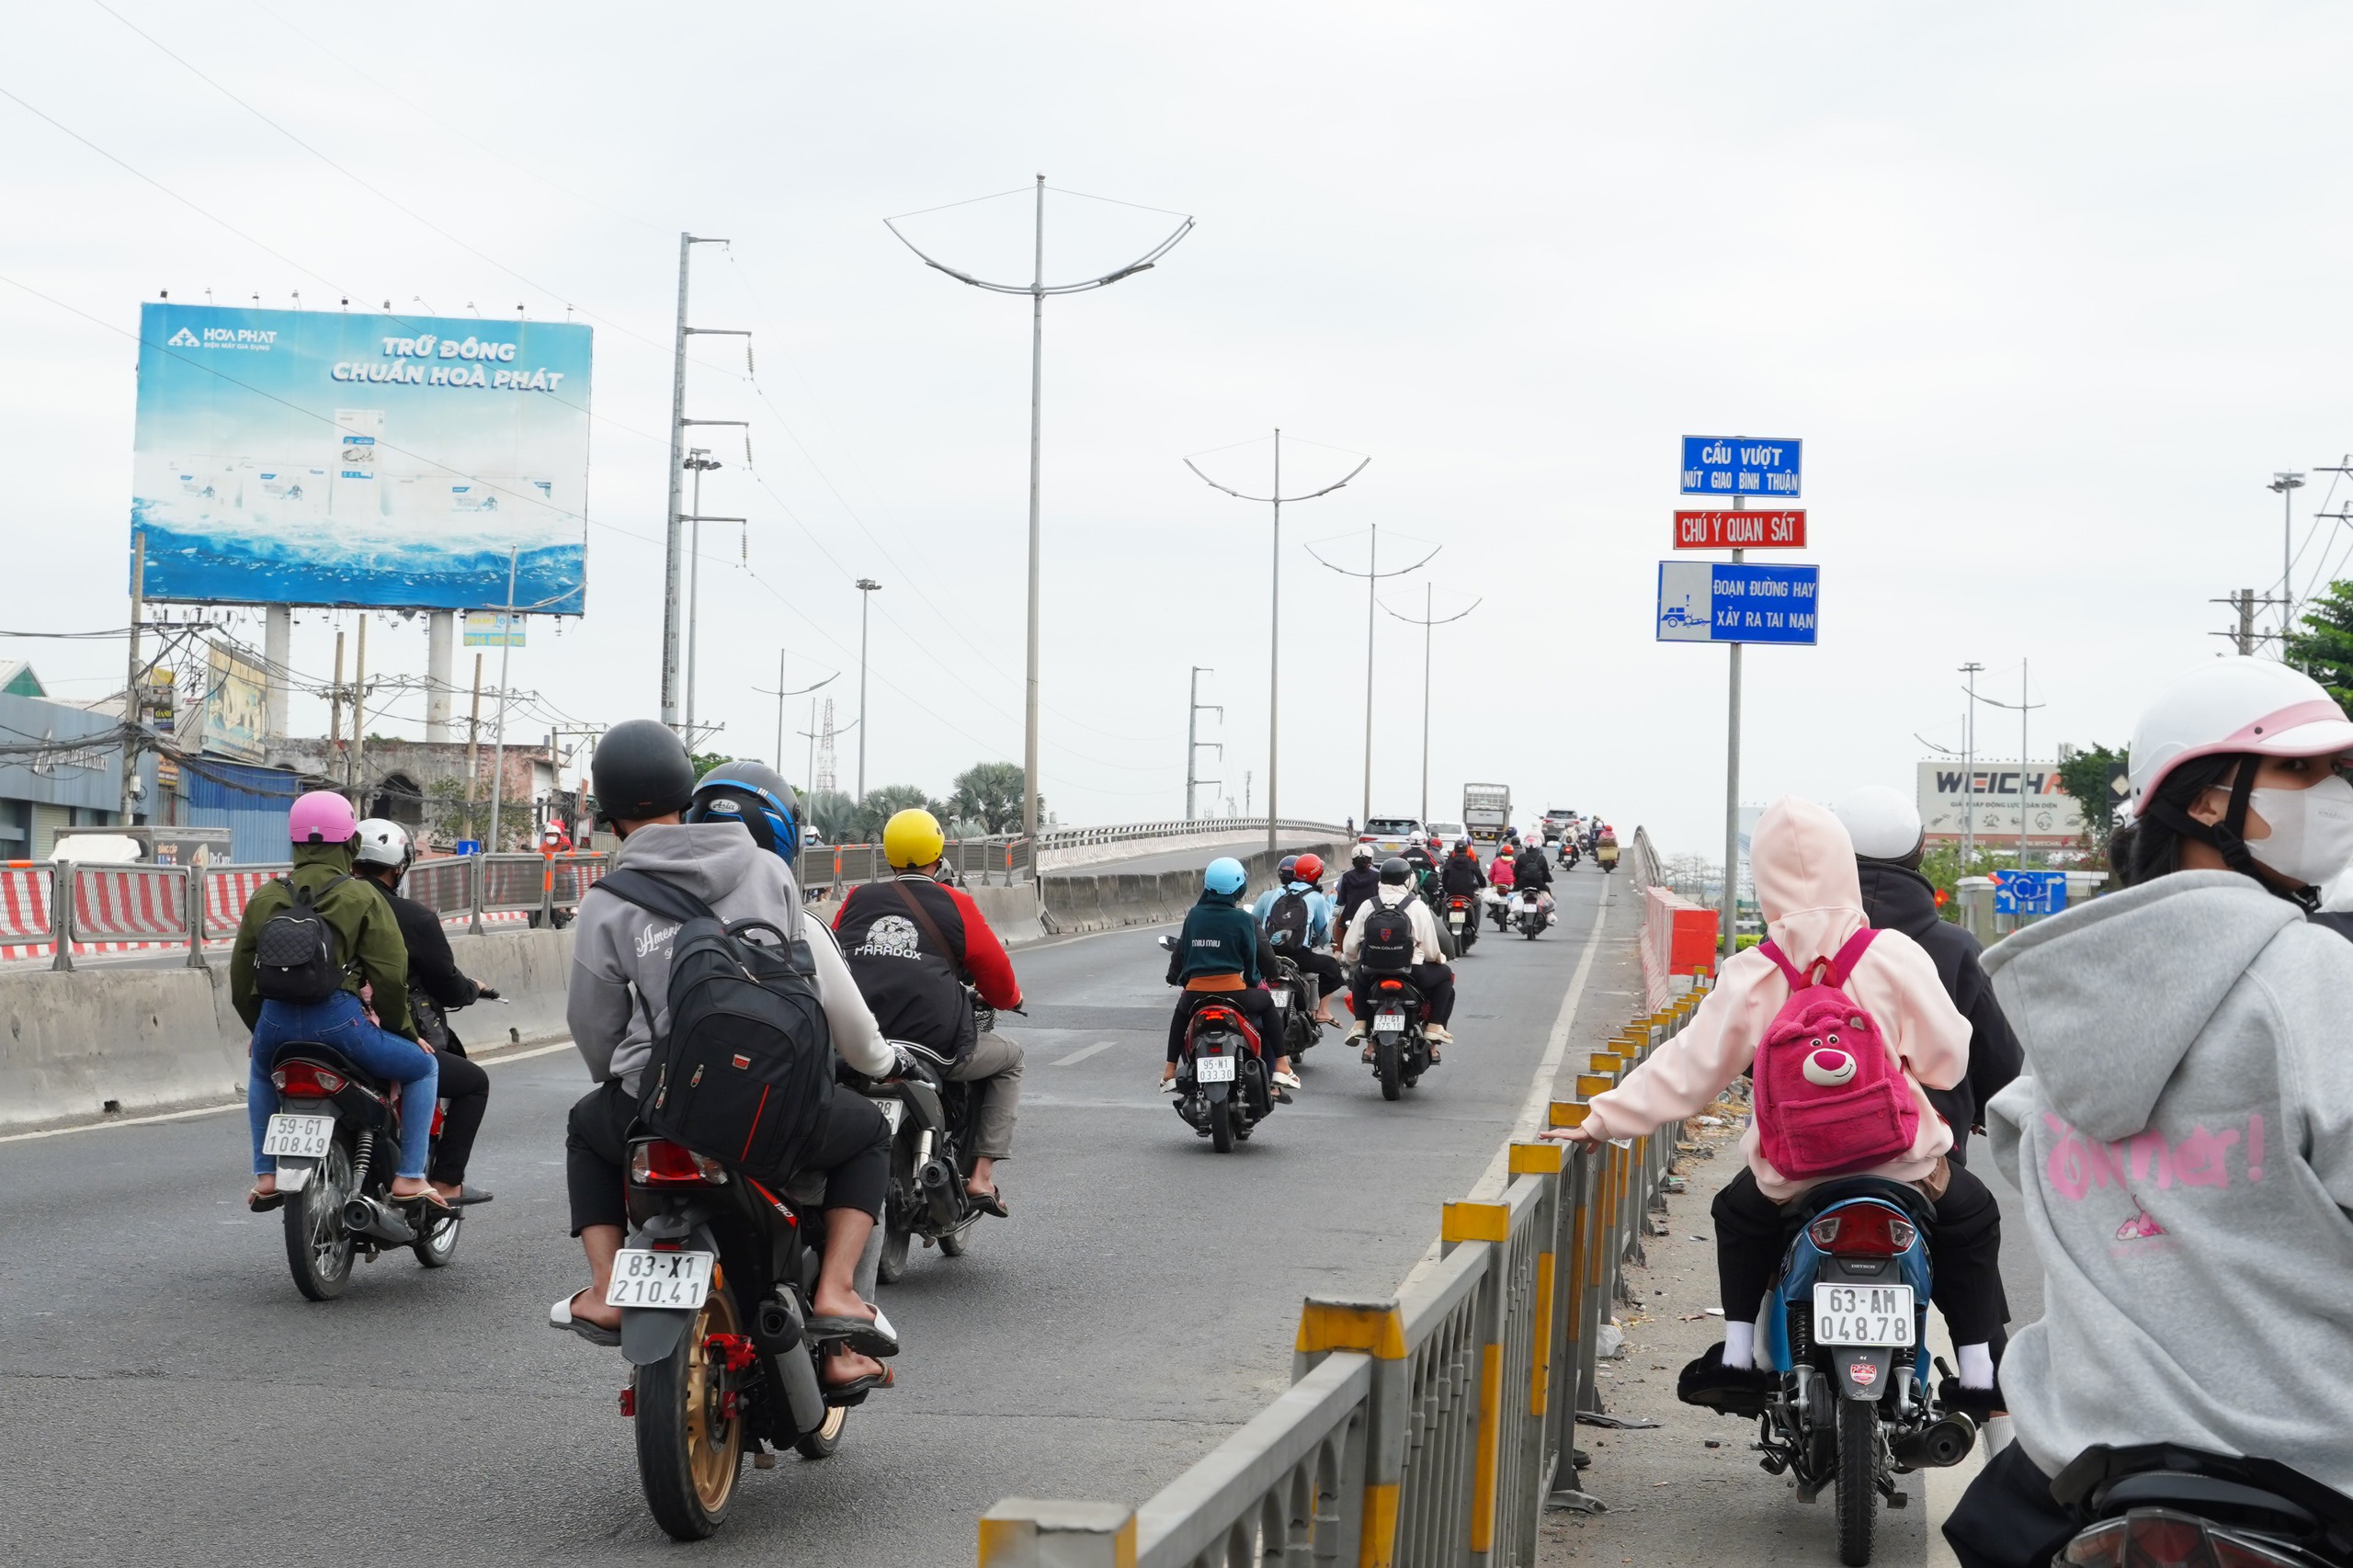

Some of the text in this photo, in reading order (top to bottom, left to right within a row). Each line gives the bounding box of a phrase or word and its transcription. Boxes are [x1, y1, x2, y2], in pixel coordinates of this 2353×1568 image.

[382, 334, 517, 362] TRỮ ĐÔNG
[428, 363, 486, 387] HOÀ
[492, 368, 564, 392] PHÁT
[1702, 439, 1783, 470] CẦU VƯỢT
[1684, 467, 1798, 494] NÚT GIAO BÌNH THUẬN
[1682, 512, 1795, 542] CHÚ Ý QUAN SÁT
[1713, 576, 1816, 597] ĐOẠN ĐƯỜNG HAY
[1716, 606, 1814, 631] XẢY RA TAI NẠN
[1937, 771, 2070, 794] WEICHA
[1199, 1069, 1233, 1081] 033.30
[1203, 1059, 1228, 1070] 95-N1
[278, 1119, 322, 1135] 59-G1
[269, 1136, 325, 1153] 108.49
[629, 1256, 695, 1278] 83-X1
[614, 1279, 699, 1304] 210.41
[1830, 1289, 1896, 1313] 63-AM
[1821, 1316, 1907, 1342] 048.78
